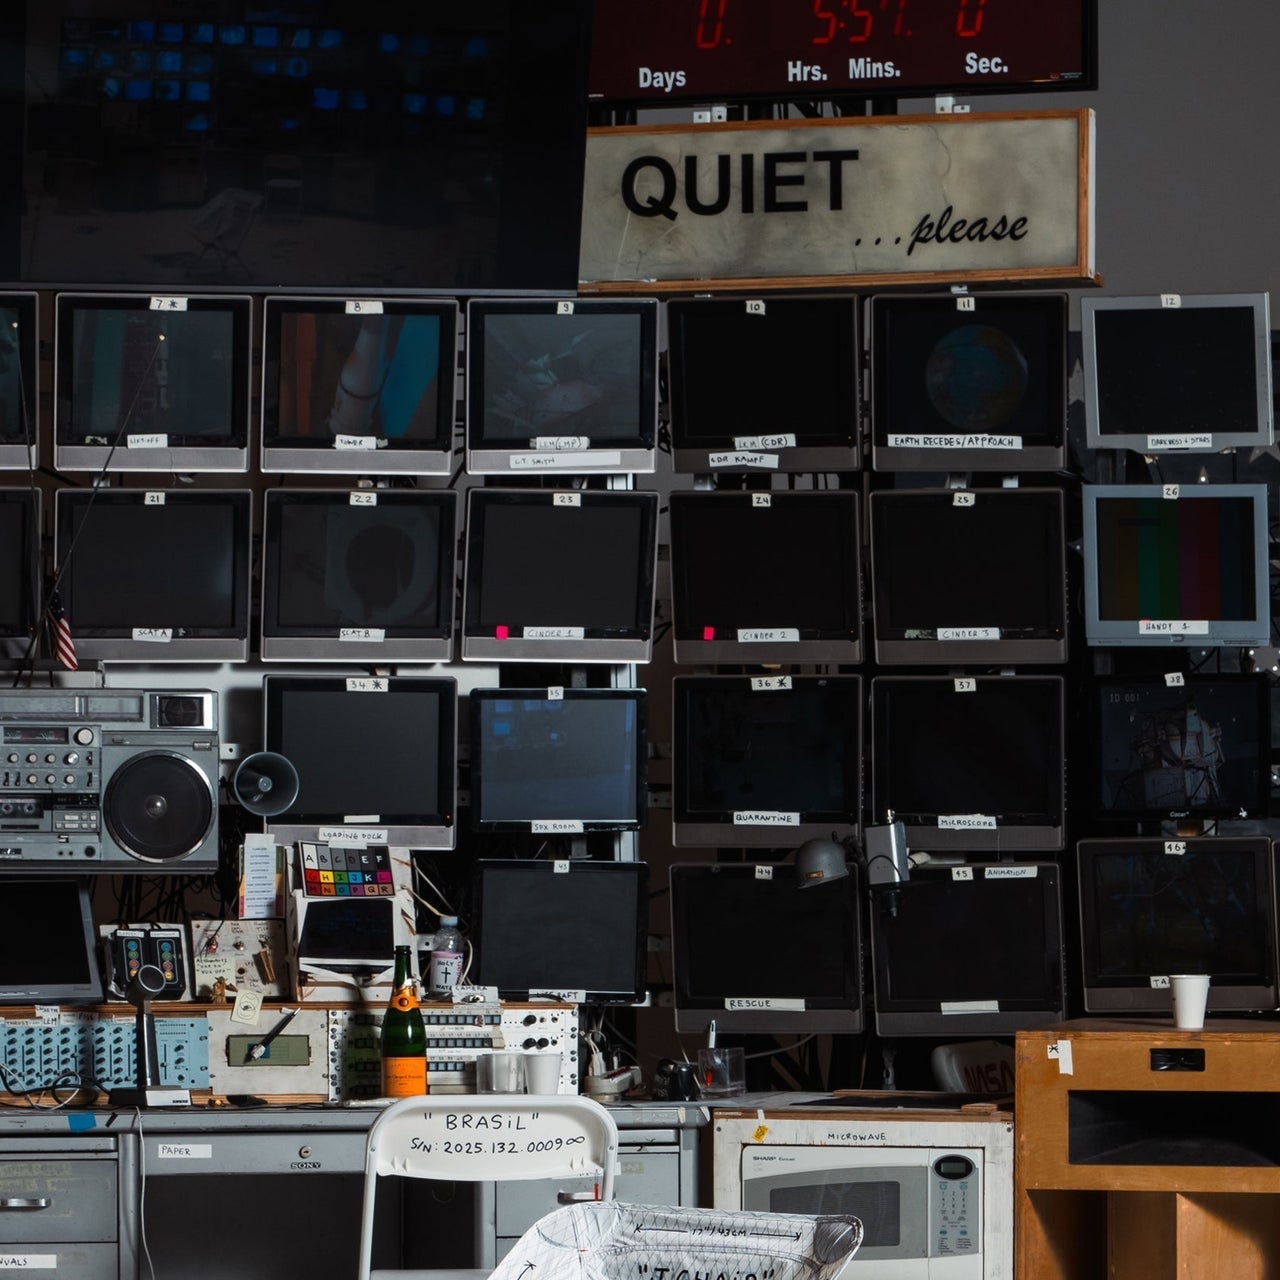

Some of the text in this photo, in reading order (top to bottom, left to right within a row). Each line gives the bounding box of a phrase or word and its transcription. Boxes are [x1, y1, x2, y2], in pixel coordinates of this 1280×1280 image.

[639, 52, 1008, 93] Days Hrs. Mins. Sec.
[621, 150, 859, 222] QUIET
[156, 299, 163, 309] 7
[354, 303, 361, 312] 8
[750, 303, 761, 311] 10
[962, 300, 971, 309] 11
[894, 436, 920, 446] EARTH
[1165, 487, 1178, 496] 26
[354, 495, 373, 504] 22
[755, 496, 769, 504] 24
[1146, 622, 1171, 630] HANDY
[528, 629, 561, 638] CINDER
[743, 632, 774, 640] CINDER
[942, 630, 978, 638] CINDER
[351, 681, 365, 689] 34
[959, 681, 970, 689] 37
[322, 832, 357, 840] LOADING
[1167, 844, 1181, 852] 46
[730, 1000, 771, 1009] RESCUE
[828, 1132, 887, 1141] MICROWAVE
[161, 1145, 191, 1155] PAPER
[290, 1162, 321, 1170] SONY
